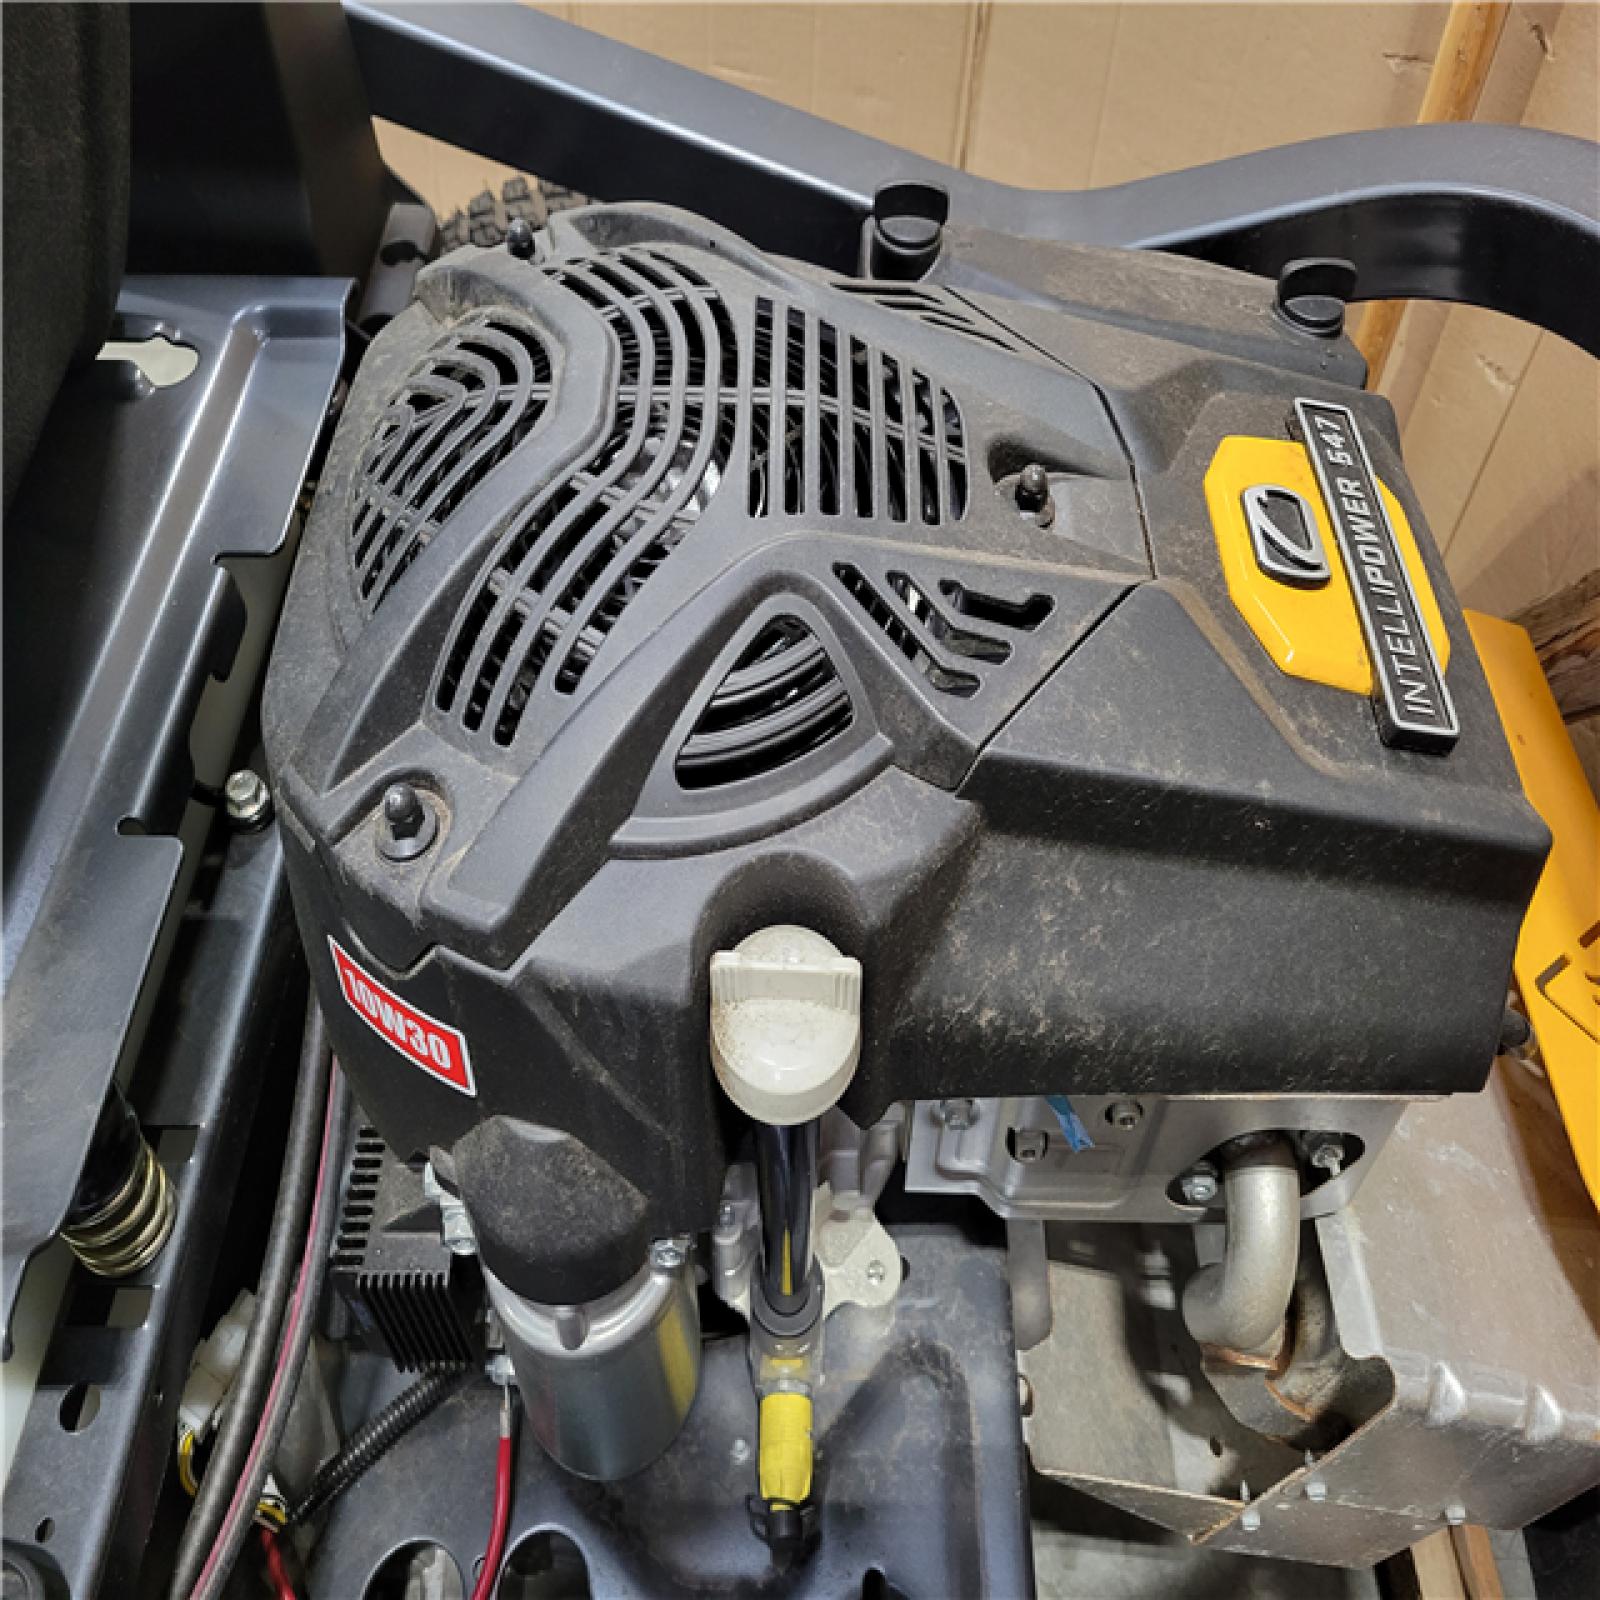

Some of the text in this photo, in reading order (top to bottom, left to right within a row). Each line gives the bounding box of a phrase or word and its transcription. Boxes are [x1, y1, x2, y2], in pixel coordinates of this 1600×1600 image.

[1314, 415, 1435, 716] INTELLIPOWER 547
[344, 969, 452, 1069] 10W30
